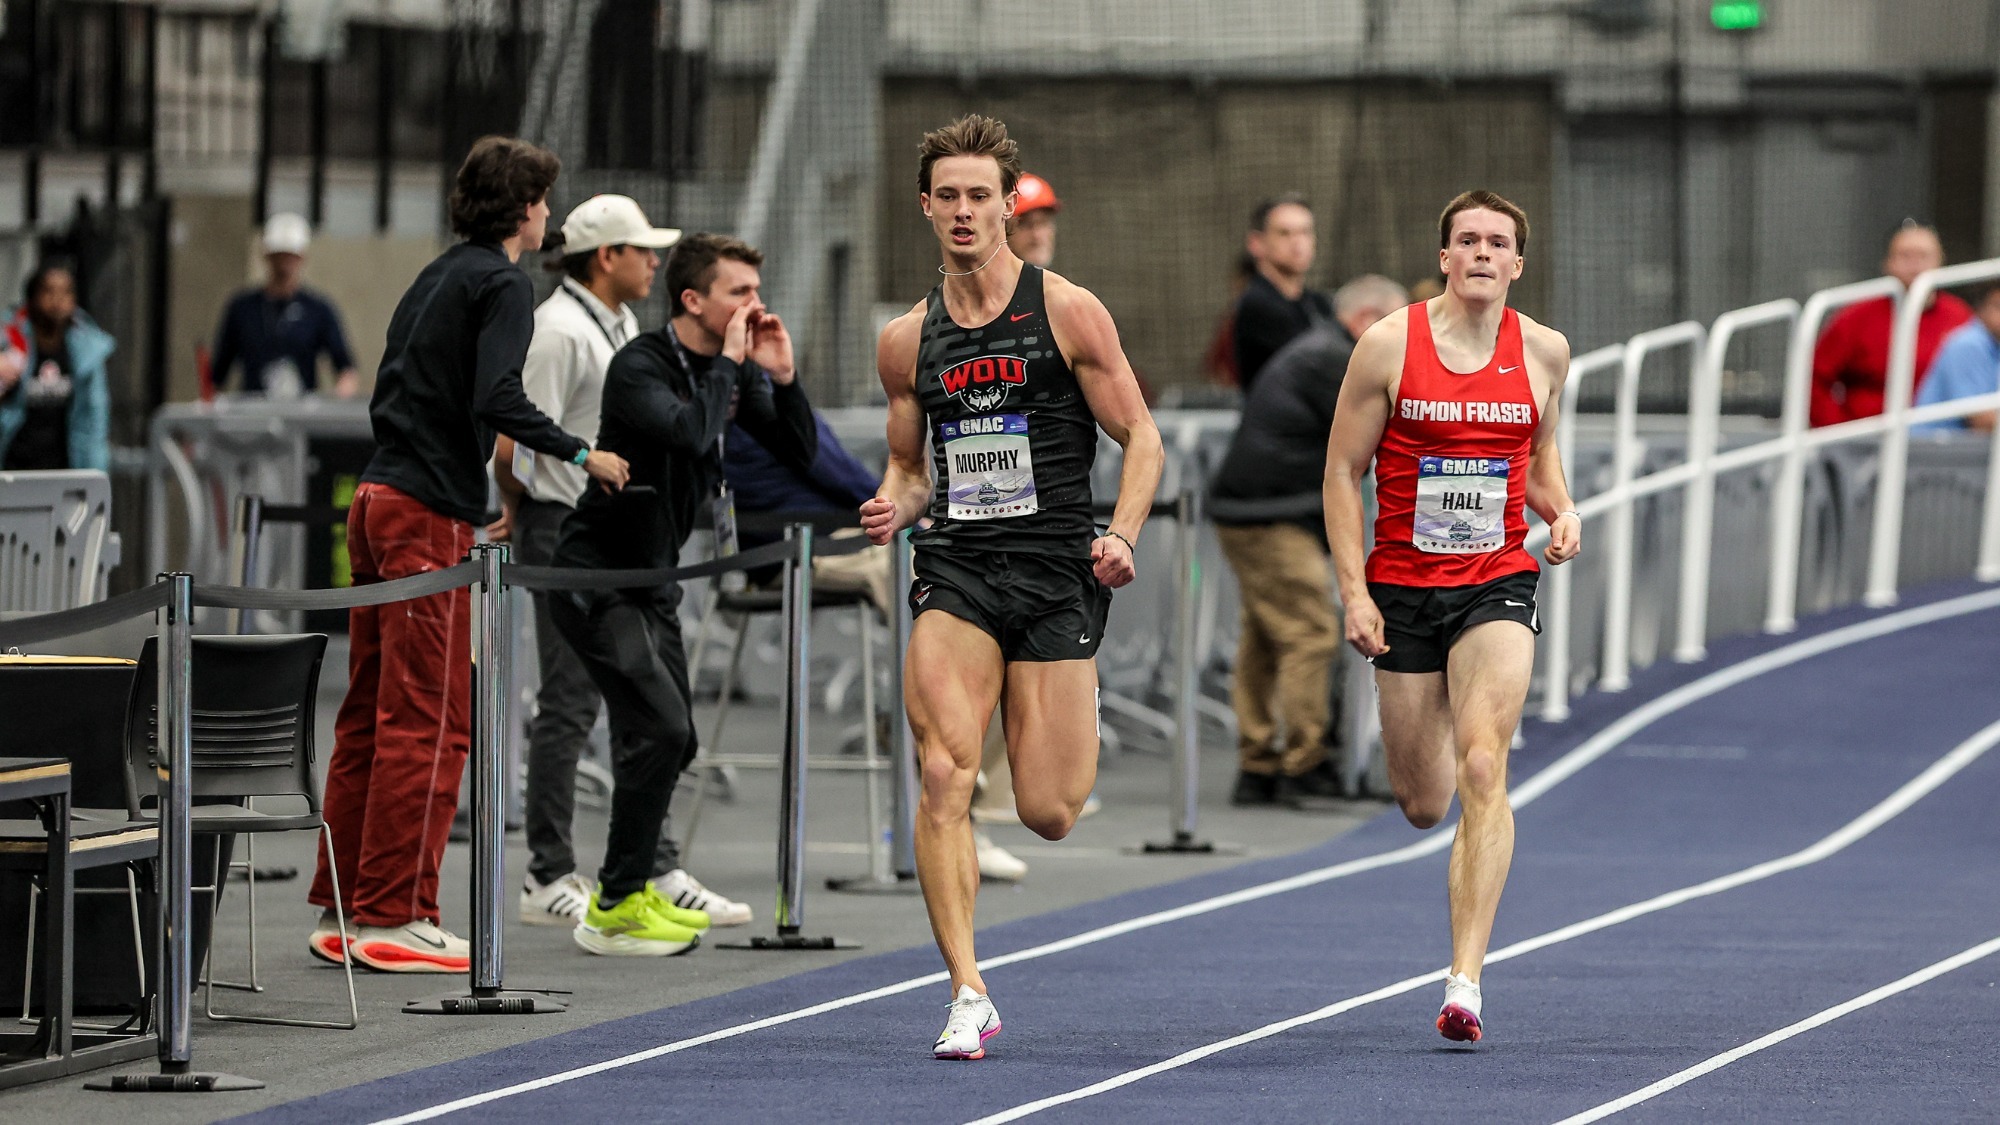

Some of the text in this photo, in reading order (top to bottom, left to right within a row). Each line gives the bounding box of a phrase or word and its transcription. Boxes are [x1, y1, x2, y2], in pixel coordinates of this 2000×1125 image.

[942, 358, 1024, 394] WOU
[1401, 399, 1532, 424] SIMON FRASER
[960, 417, 1004, 435] GNAC
[955, 449, 1018, 473] MURPHY
[1442, 459, 1489, 475] GNAC
[1442, 492, 1483, 510] HALL
